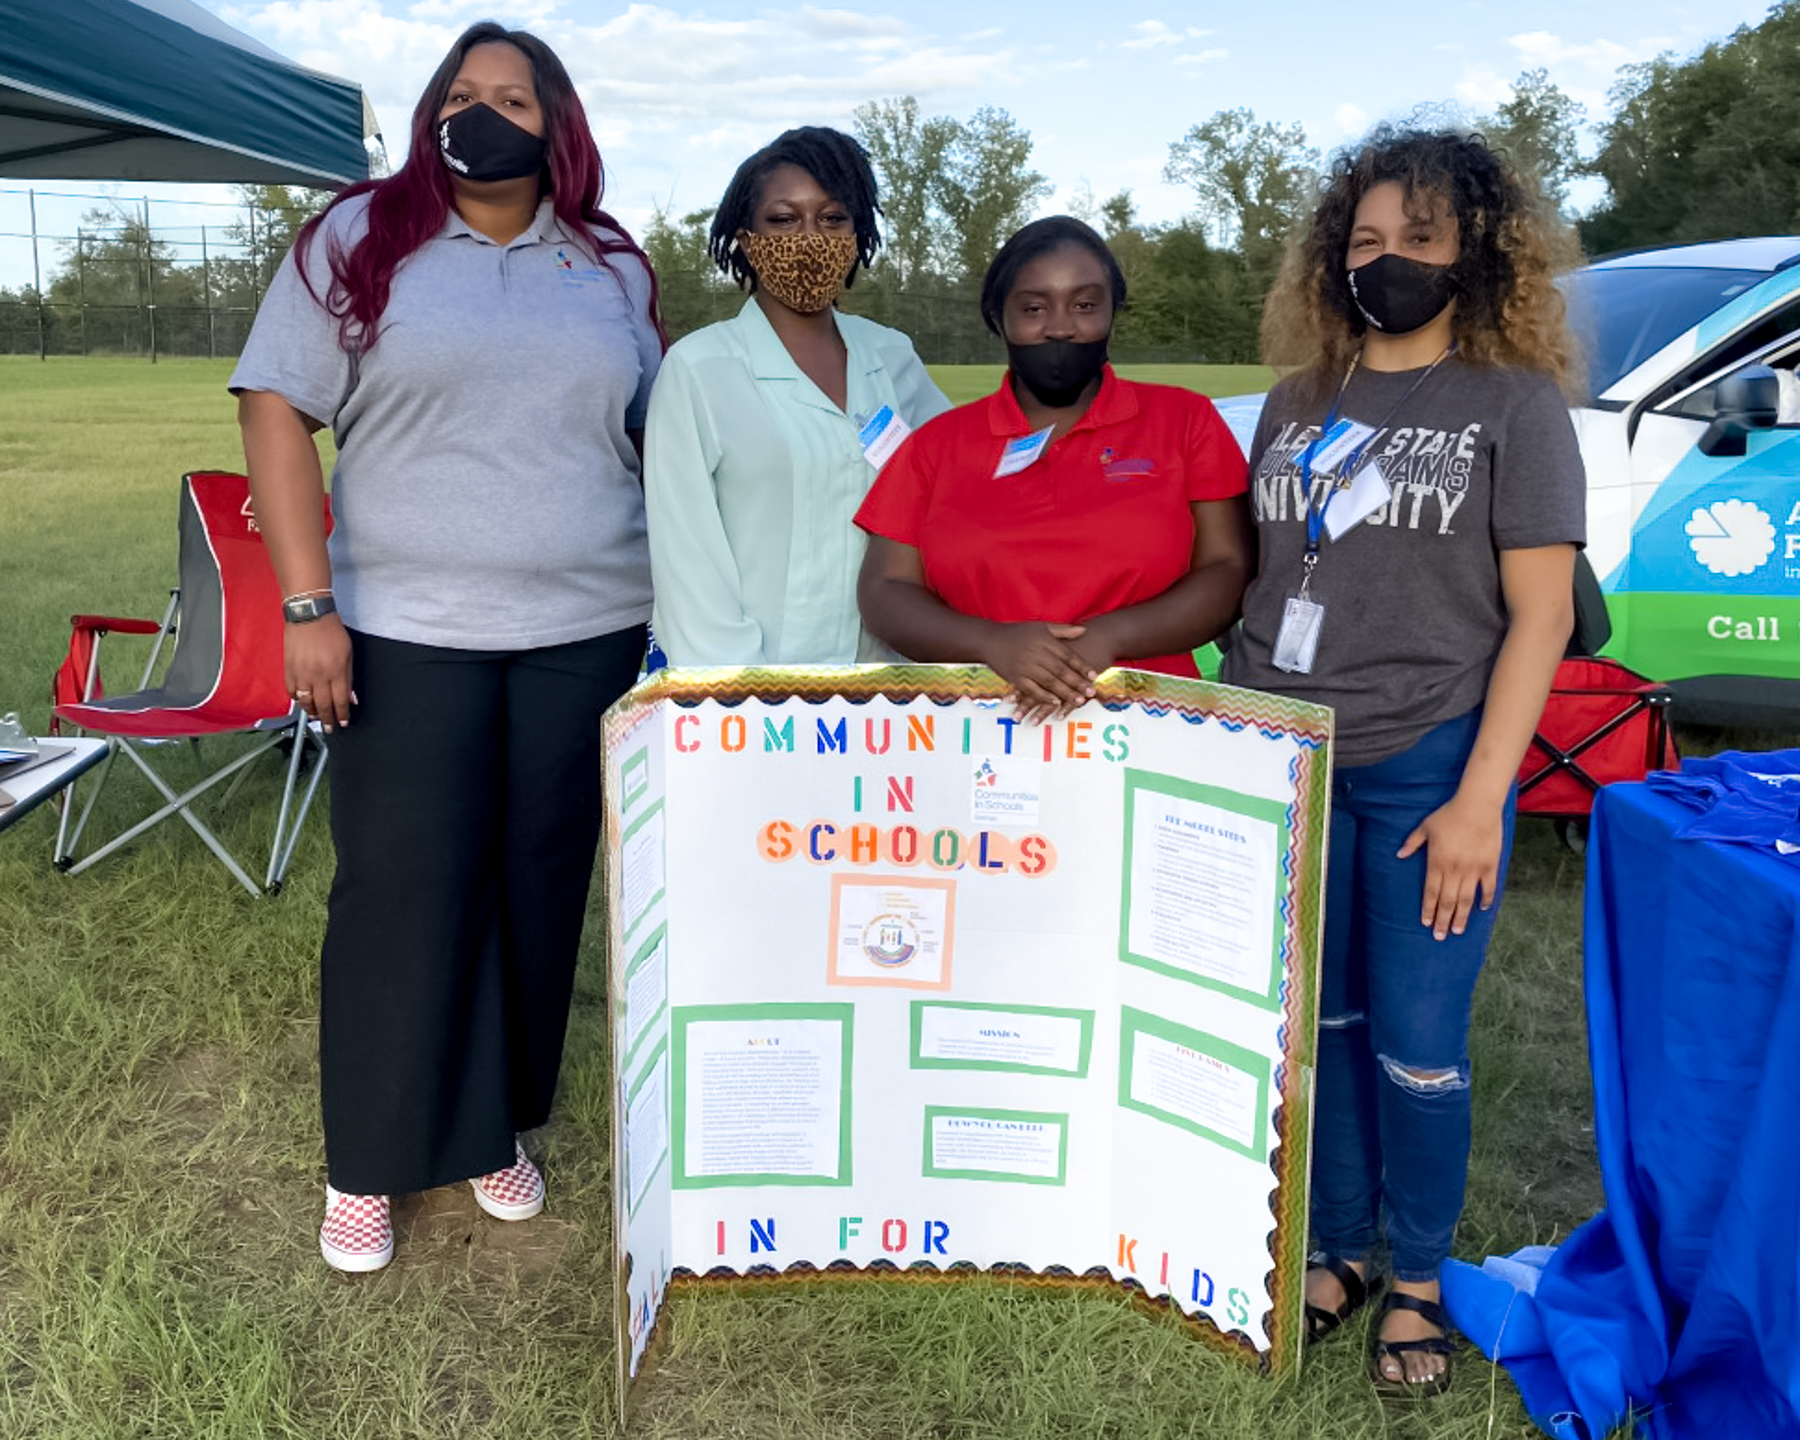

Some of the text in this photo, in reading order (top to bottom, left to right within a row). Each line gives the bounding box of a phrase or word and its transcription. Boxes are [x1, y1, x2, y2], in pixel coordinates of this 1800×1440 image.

[1384, 423, 1482, 458] STATE
[1707, 615, 1780, 641] Call
[675, 714, 1130, 762] COMMUNITIES
[854, 776, 914, 813] IN
[766, 821, 1047, 874] SCHOOLS
[717, 1217, 778, 1255] IN
[839, 1217, 950, 1256] FOR
[1117, 1233, 1251, 1326] KIDS
